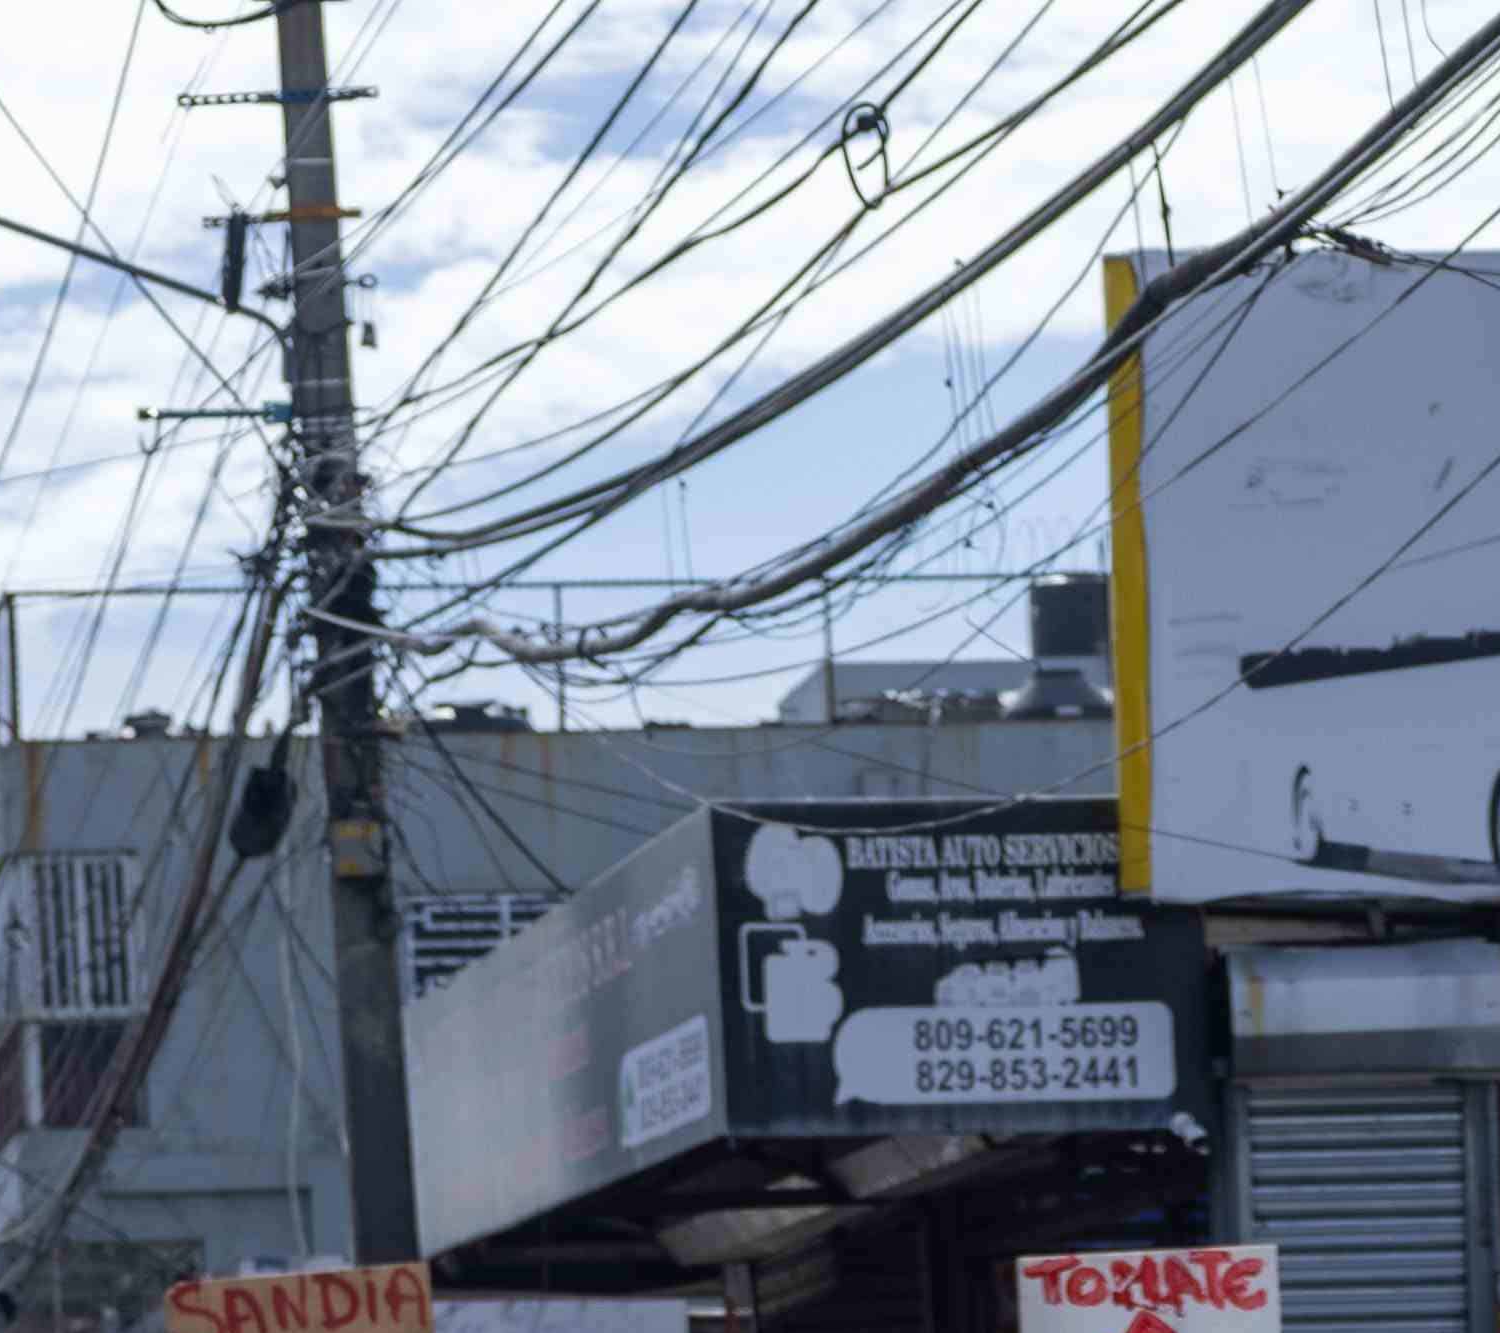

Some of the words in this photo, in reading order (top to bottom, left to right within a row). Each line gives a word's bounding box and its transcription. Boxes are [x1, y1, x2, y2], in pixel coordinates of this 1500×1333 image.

[845, 835, 938, 869] BATISTA
[940, 834, 1001, 867] AUTO
[1003, 832, 1119, 866] SERVICIOS
[914, 1015, 1140, 1052] 809-621-5699
[914, 1056, 1140, 1093] 829-853-2441
[1023, 1250, 1268, 1311] TOMATE
